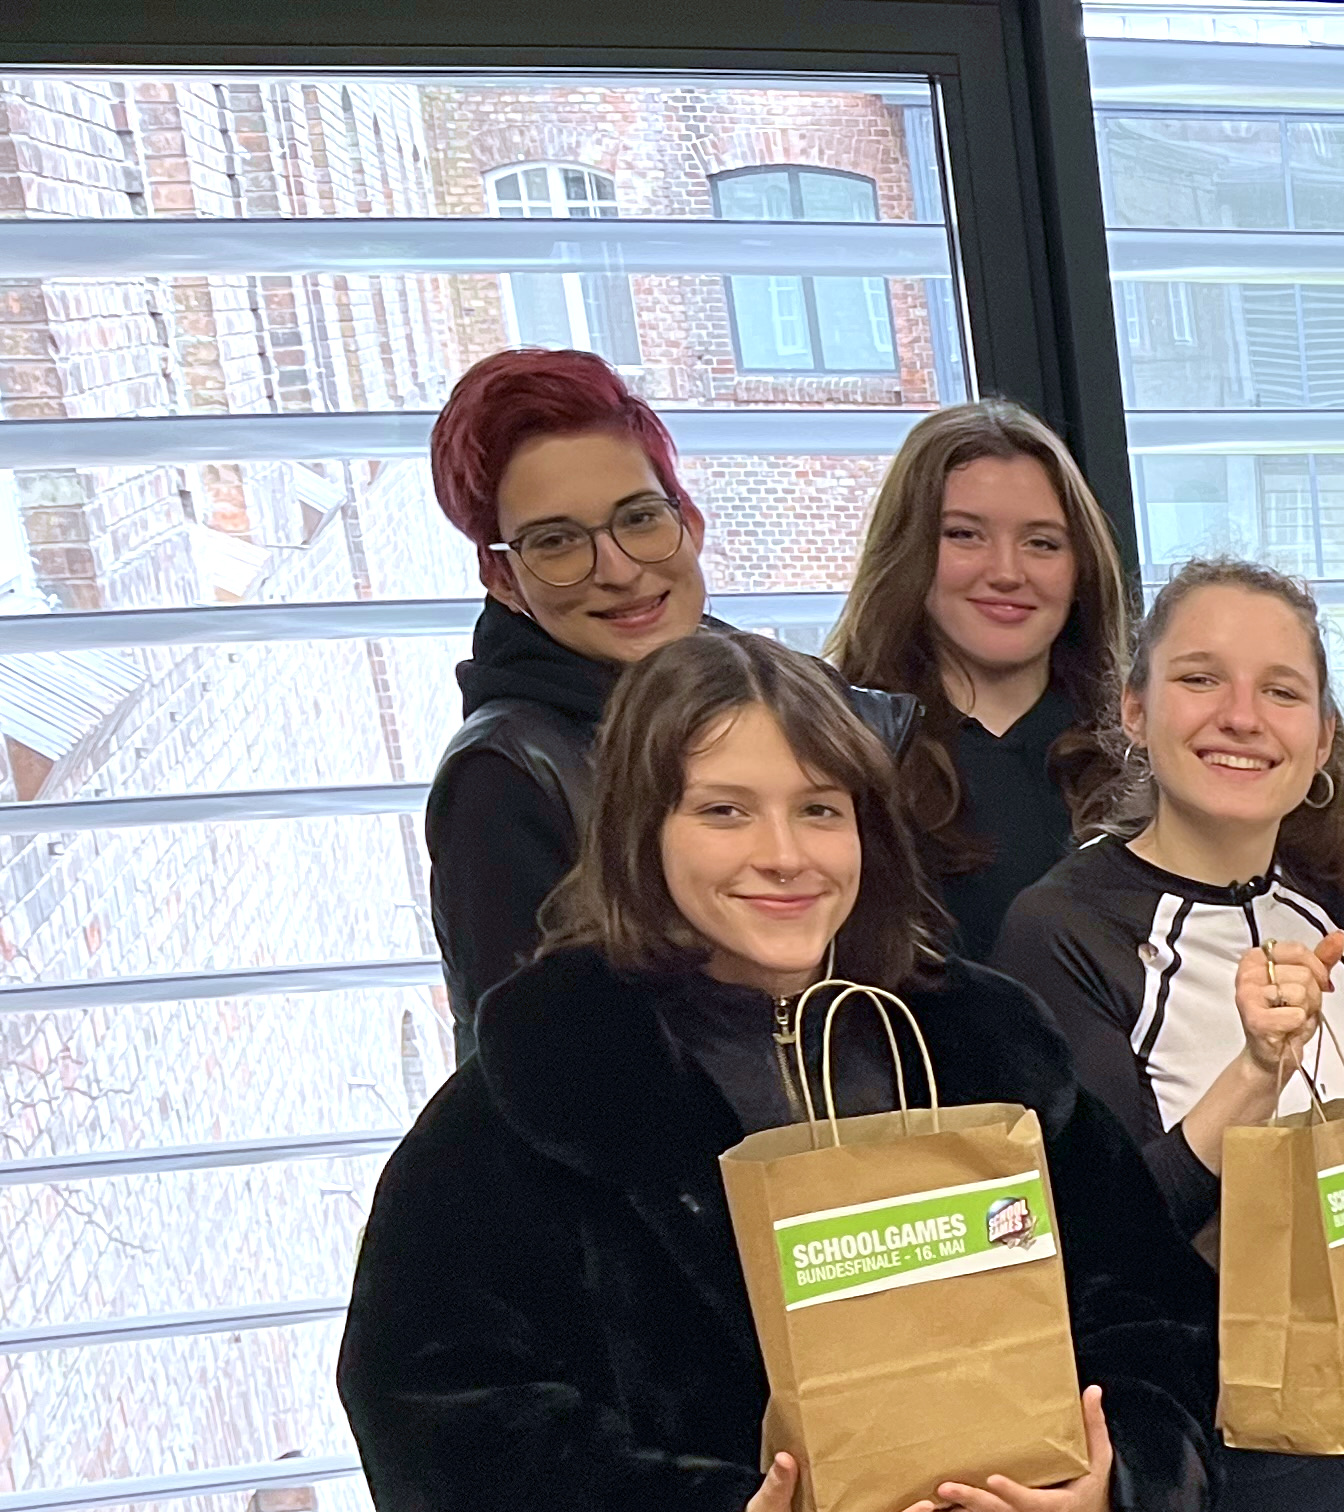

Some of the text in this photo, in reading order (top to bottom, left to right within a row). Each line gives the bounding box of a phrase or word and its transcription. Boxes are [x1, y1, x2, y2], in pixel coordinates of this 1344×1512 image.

[793, 1214, 967, 1268] SCHOOLGAMES
[796, 1250, 901, 1286] BUNDESFINALE
[914, 1246, 937, 1262] 16.
[941, 1239, 966, 1257] MAI
